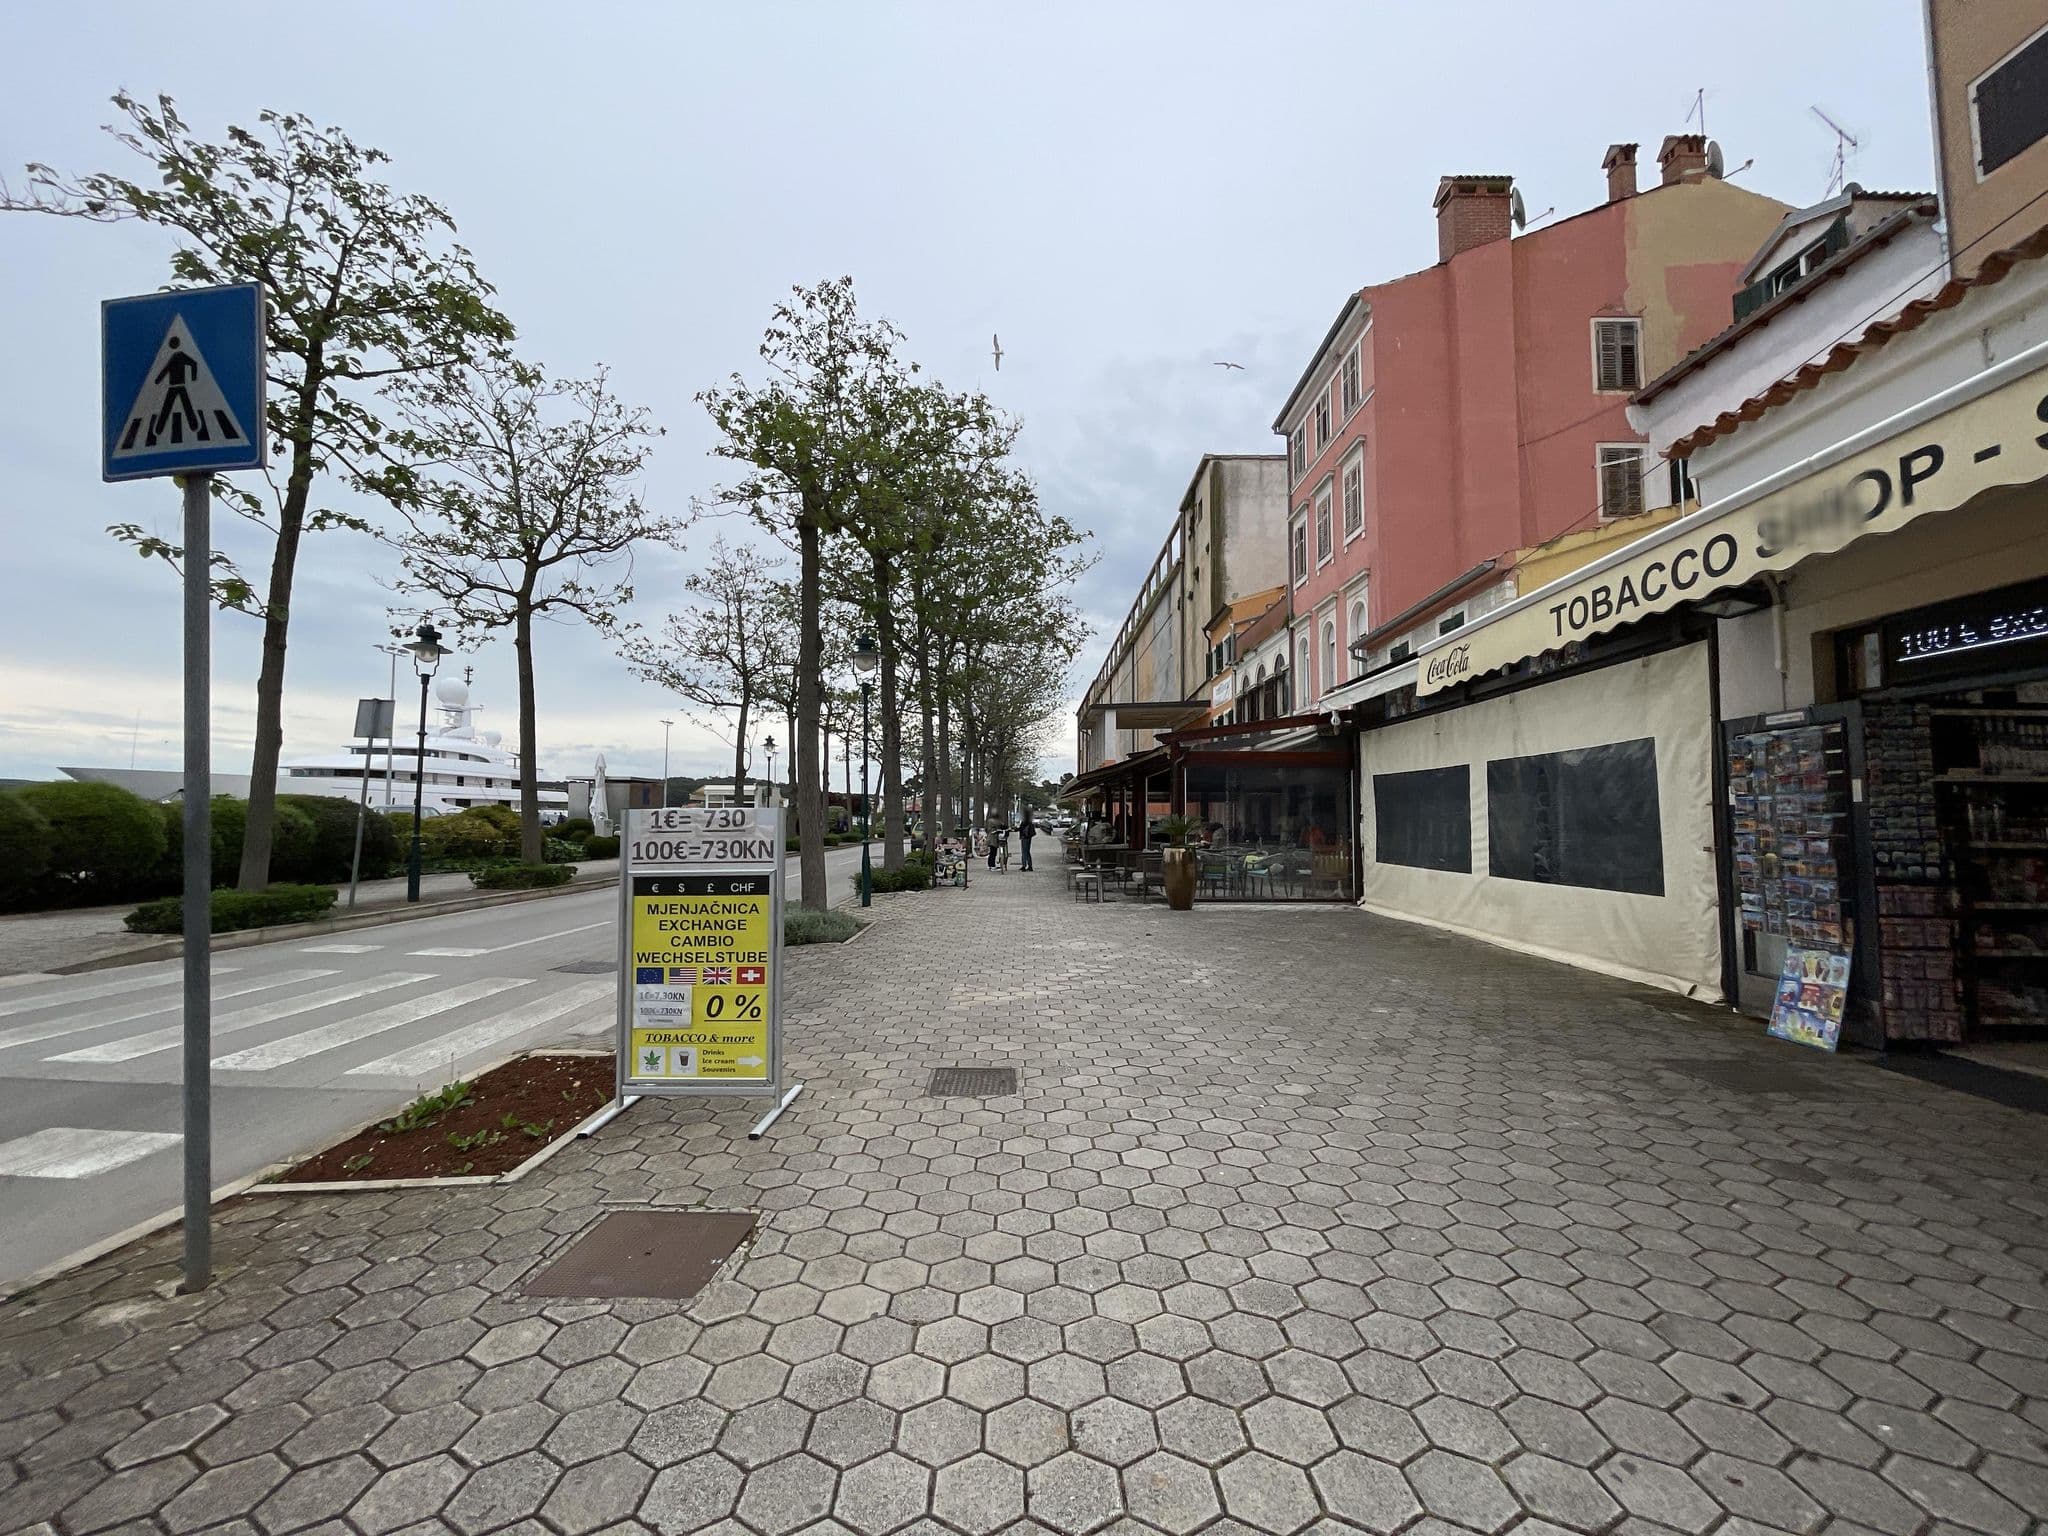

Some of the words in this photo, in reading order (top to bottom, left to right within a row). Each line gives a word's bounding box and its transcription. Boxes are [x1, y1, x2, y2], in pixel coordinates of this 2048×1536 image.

[1549, 533, 1738, 636] TOBACCO
[650, 809, 692, 829] 1€=
[703, 808, 746, 828] 730
[631, 839, 775, 860] 100€=730KN
[651, 883, 660, 893] €
[706, 883, 715, 893] £
[730, 882, 756, 893] CHF
[646, 901, 760, 915] MJENJAČNICA
[658, 919, 747, 931] EXCHANGE
[670, 935, 734, 947] CAMBIO
[636, 951, 768, 963] WECHSELSTUBE
[706, 994, 724, 1018] 0
[735, 993, 762, 1019] %
[645, 1033, 707, 1043] TOBACCO
[708, 1033, 720, 1043] &
[722, 1035, 756, 1043] more
